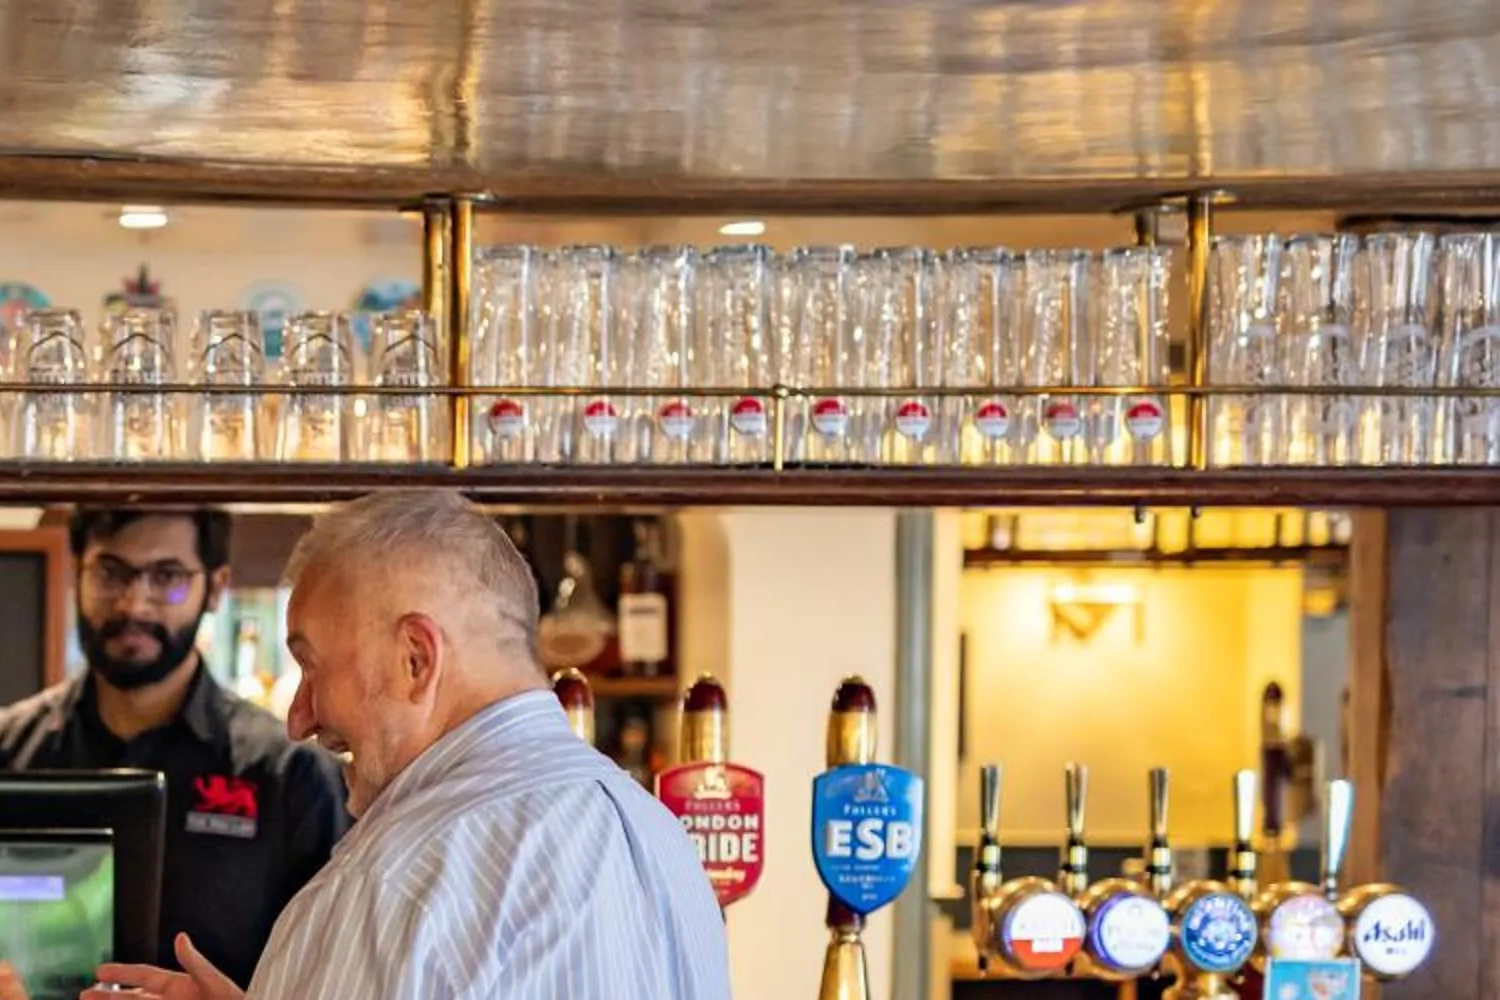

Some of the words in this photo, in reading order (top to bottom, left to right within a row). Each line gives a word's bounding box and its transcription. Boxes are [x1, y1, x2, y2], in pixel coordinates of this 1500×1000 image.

[678, 814, 759, 830] ONDON
[689, 832, 759, 863] RIDE
[826, 818, 912, 860] ESB
